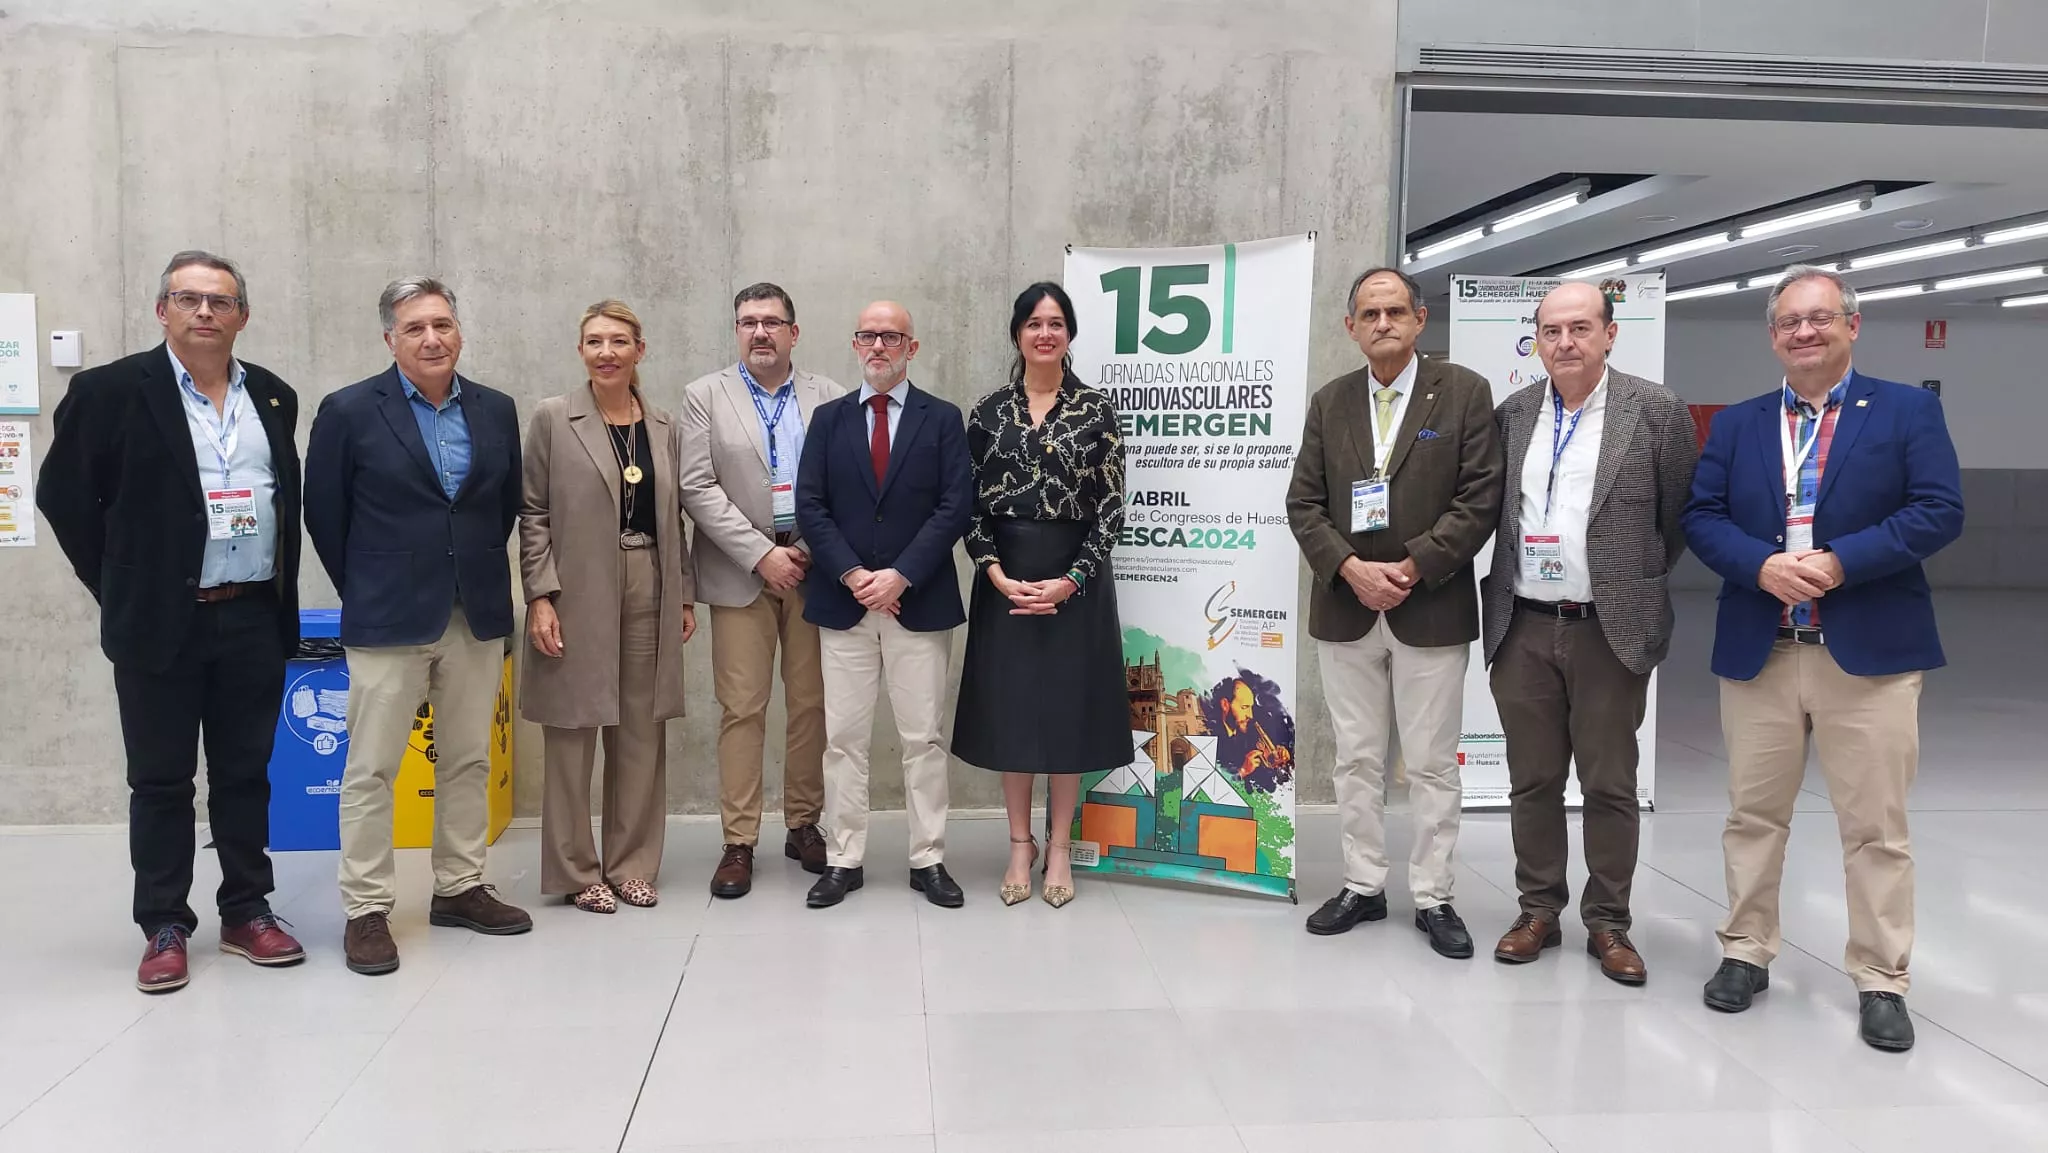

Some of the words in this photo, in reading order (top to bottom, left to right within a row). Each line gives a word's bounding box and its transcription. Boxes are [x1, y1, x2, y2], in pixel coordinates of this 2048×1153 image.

[1456, 280, 1478, 298] 15
[1526, 290, 1547, 298] HUES
[1100, 264, 1211, 354] 15
[1521, 316, 1537, 324] Pat
[0, 341, 20, 349] ZAR
[1099, 362, 1175, 384] JORNADAS
[1179, 360, 1274, 383] NACIONALES
[1118, 413, 1271, 437] EMERGEN
[1125, 445, 1142, 455] ona
[1144, 444, 1178, 456] puede
[1180, 445, 1200, 456] ser,
[1204, 443, 1214, 454] si
[1216, 445, 1230, 454] se
[1233, 443, 1243, 454] lo
[1246, 445, 1294, 457] propone,
[1135, 457, 1184, 468] escultora
[1187, 457, 1201, 468] de
[1203, 459, 1217, 469] su
[1219, 458, 1255, 470] propia
[1126, 490, 1190, 506] /ABRIL
[209, 503, 224, 514] 15
[1354, 500, 1364, 509] 15
[1129, 509, 1146, 522] de
[1150, 509, 1221, 525] Congresos
[1226, 511, 1243, 524] de
[1247, 511, 1289, 525] Huesc
[1118, 526, 1256, 550] ESCA2024
[1525, 546, 1536, 556] 15
[1113, 563, 1198, 573] dascardiovasculares.com
[1114, 573, 1178, 583] SEMERGEN24
[1230, 608, 1287, 620] SEMERGEN
[1262, 620, 1276, 631] AP
